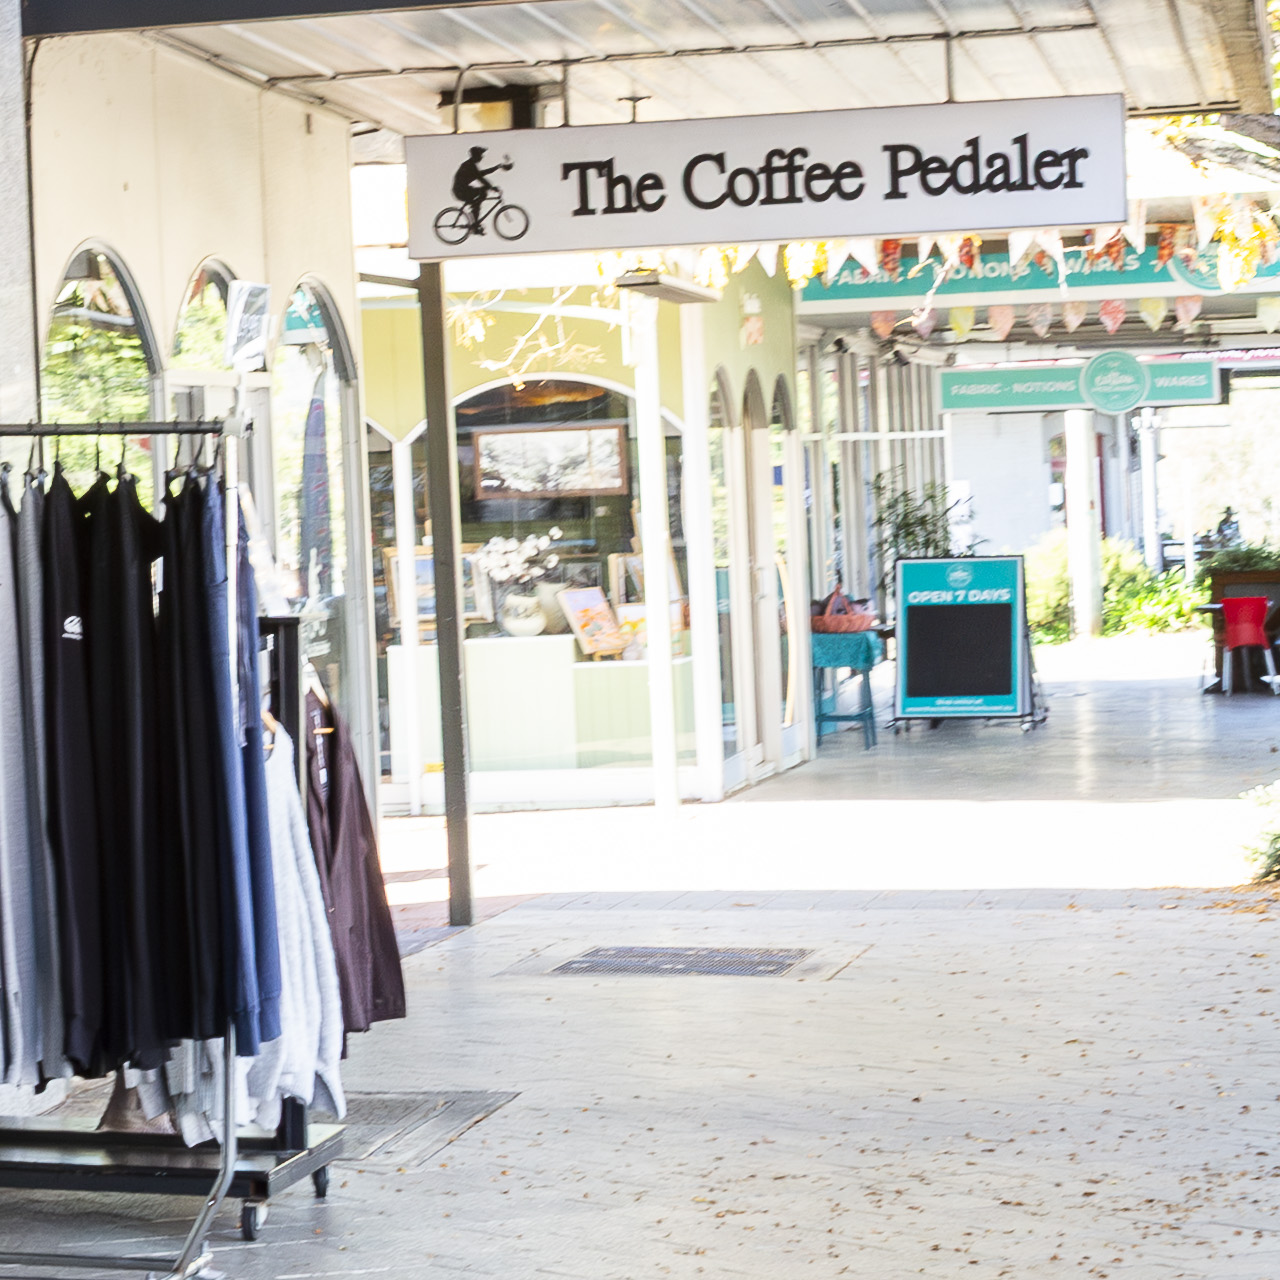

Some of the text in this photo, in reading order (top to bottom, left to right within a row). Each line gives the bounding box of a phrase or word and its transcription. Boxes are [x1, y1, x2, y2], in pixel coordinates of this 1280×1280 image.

[562, 132, 1090, 216] The Coffee Pedaler
[951, 383, 1002, 395] FABRIC
[1012, 380, 1077, 394] NOTIONS
[1154, 374, 1209, 388] WARES
[908, 588, 1012, 603] OPEN 7 DAYS
